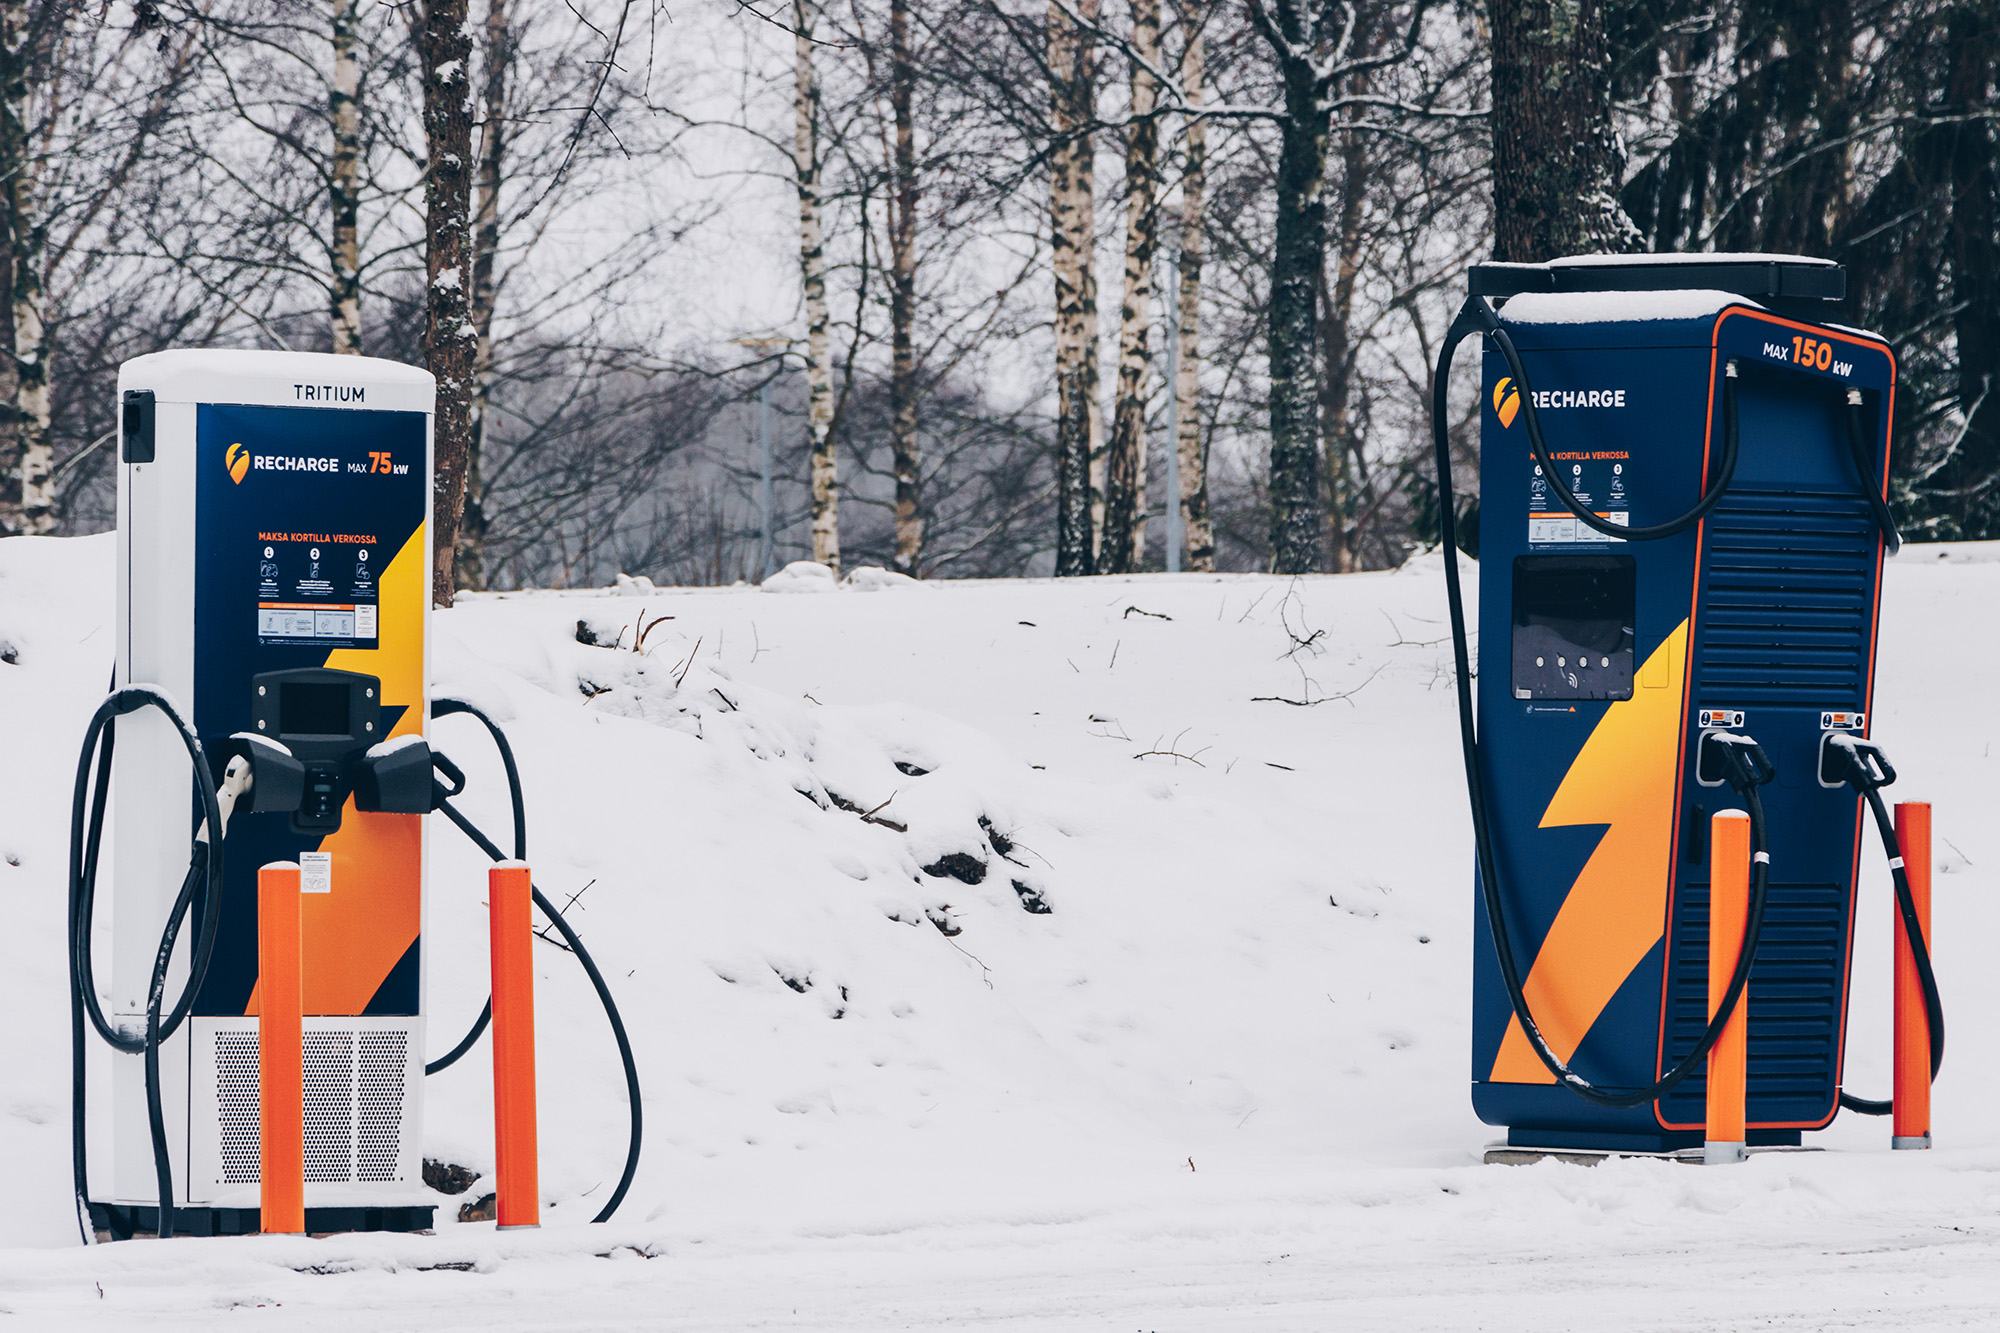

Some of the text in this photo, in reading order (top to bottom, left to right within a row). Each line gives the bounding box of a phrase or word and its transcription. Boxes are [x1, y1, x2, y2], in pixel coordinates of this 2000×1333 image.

[1763, 336, 1853, 377] MAX 150 kW
[294, 384, 365, 402] TRITIUM
[1531, 390, 1626, 408] RECHARGE
[254, 451, 409, 475] RECHARGE MAX 75 kW
[1556, 452, 1590, 460] KORTILLA
[1591, 451, 1629, 459] VERKOSSA
[258, 532, 377, 544] MAKSA KORTILLA VERKOSSA
